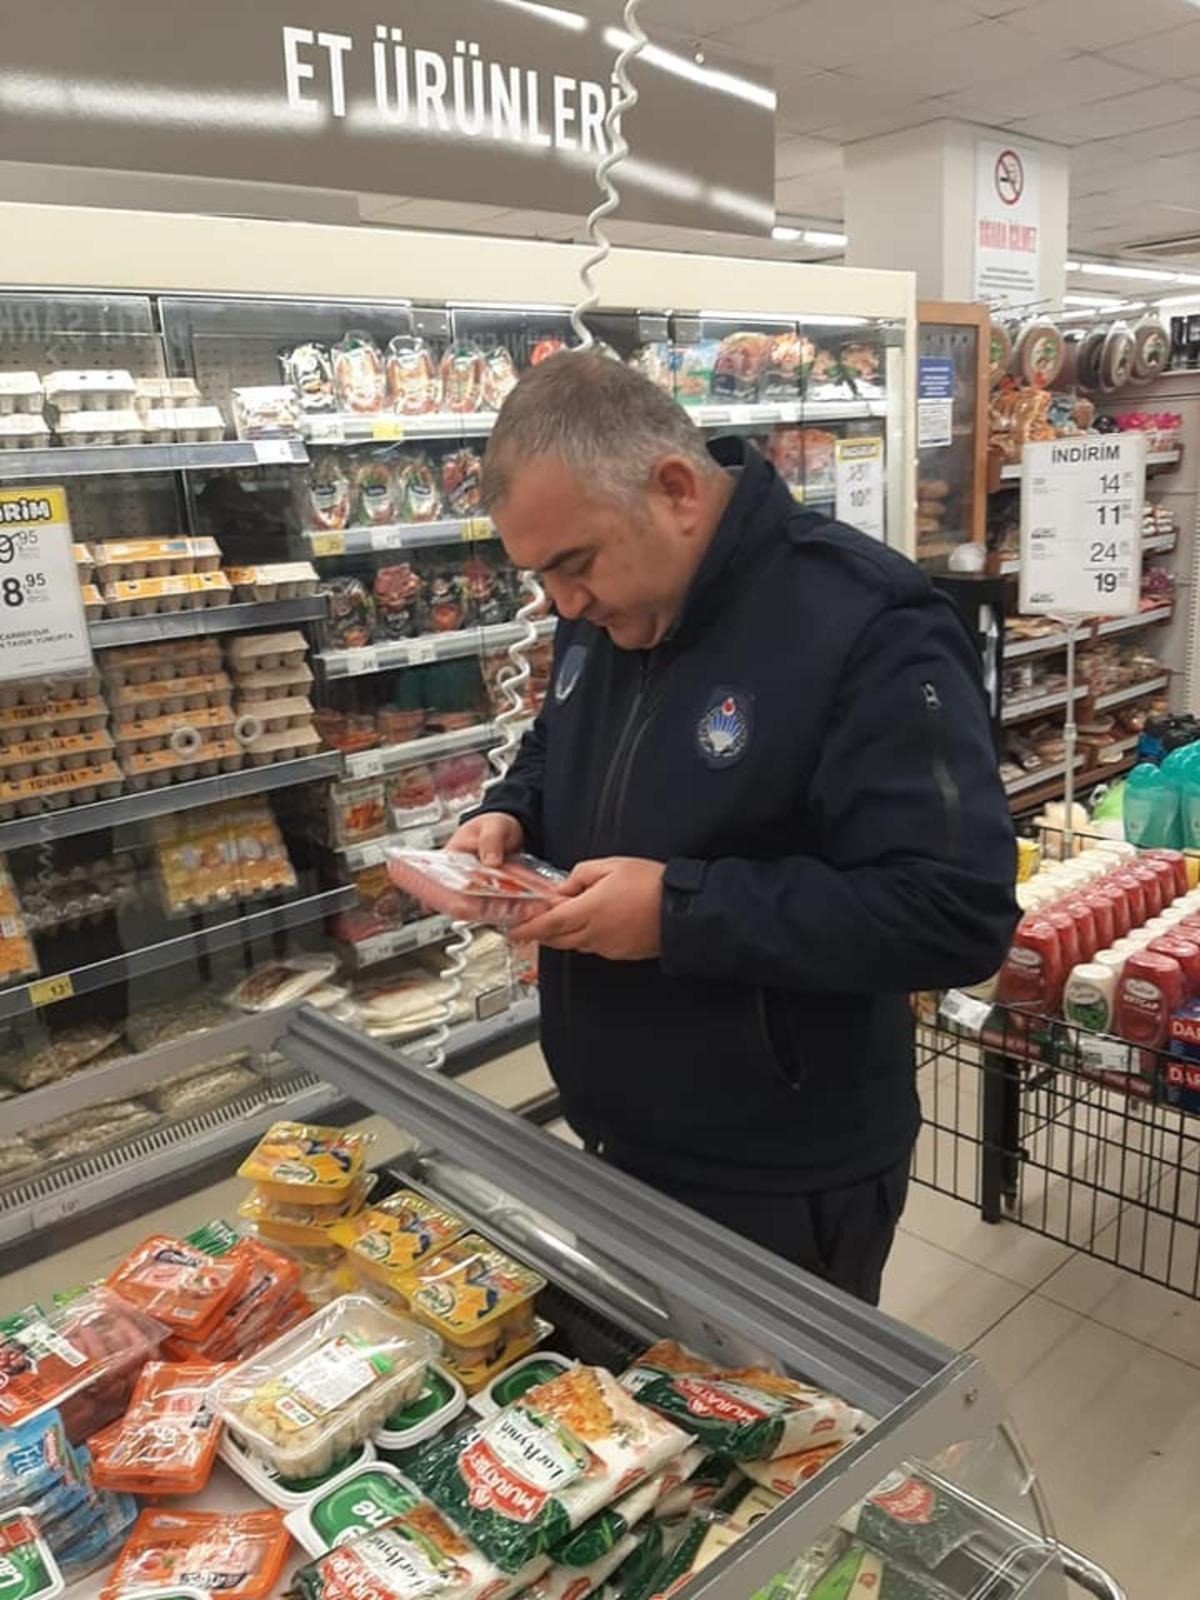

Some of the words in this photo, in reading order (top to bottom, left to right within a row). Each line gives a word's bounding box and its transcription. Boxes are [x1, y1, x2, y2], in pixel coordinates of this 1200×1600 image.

[283, 26, 353, 117] ET
[372, 25, 622, 154] ÜRÜNLERİ
[1052, 443, 1121, 464] İNDİRİM
[1099, 474, 1121, 494] 14
[0, 499, 51, 523] RİM
[1097, 505, 1120, 526] 11
[1090, 542, 1118, 563] 24
[1094, 572, 1118, 593] 19
